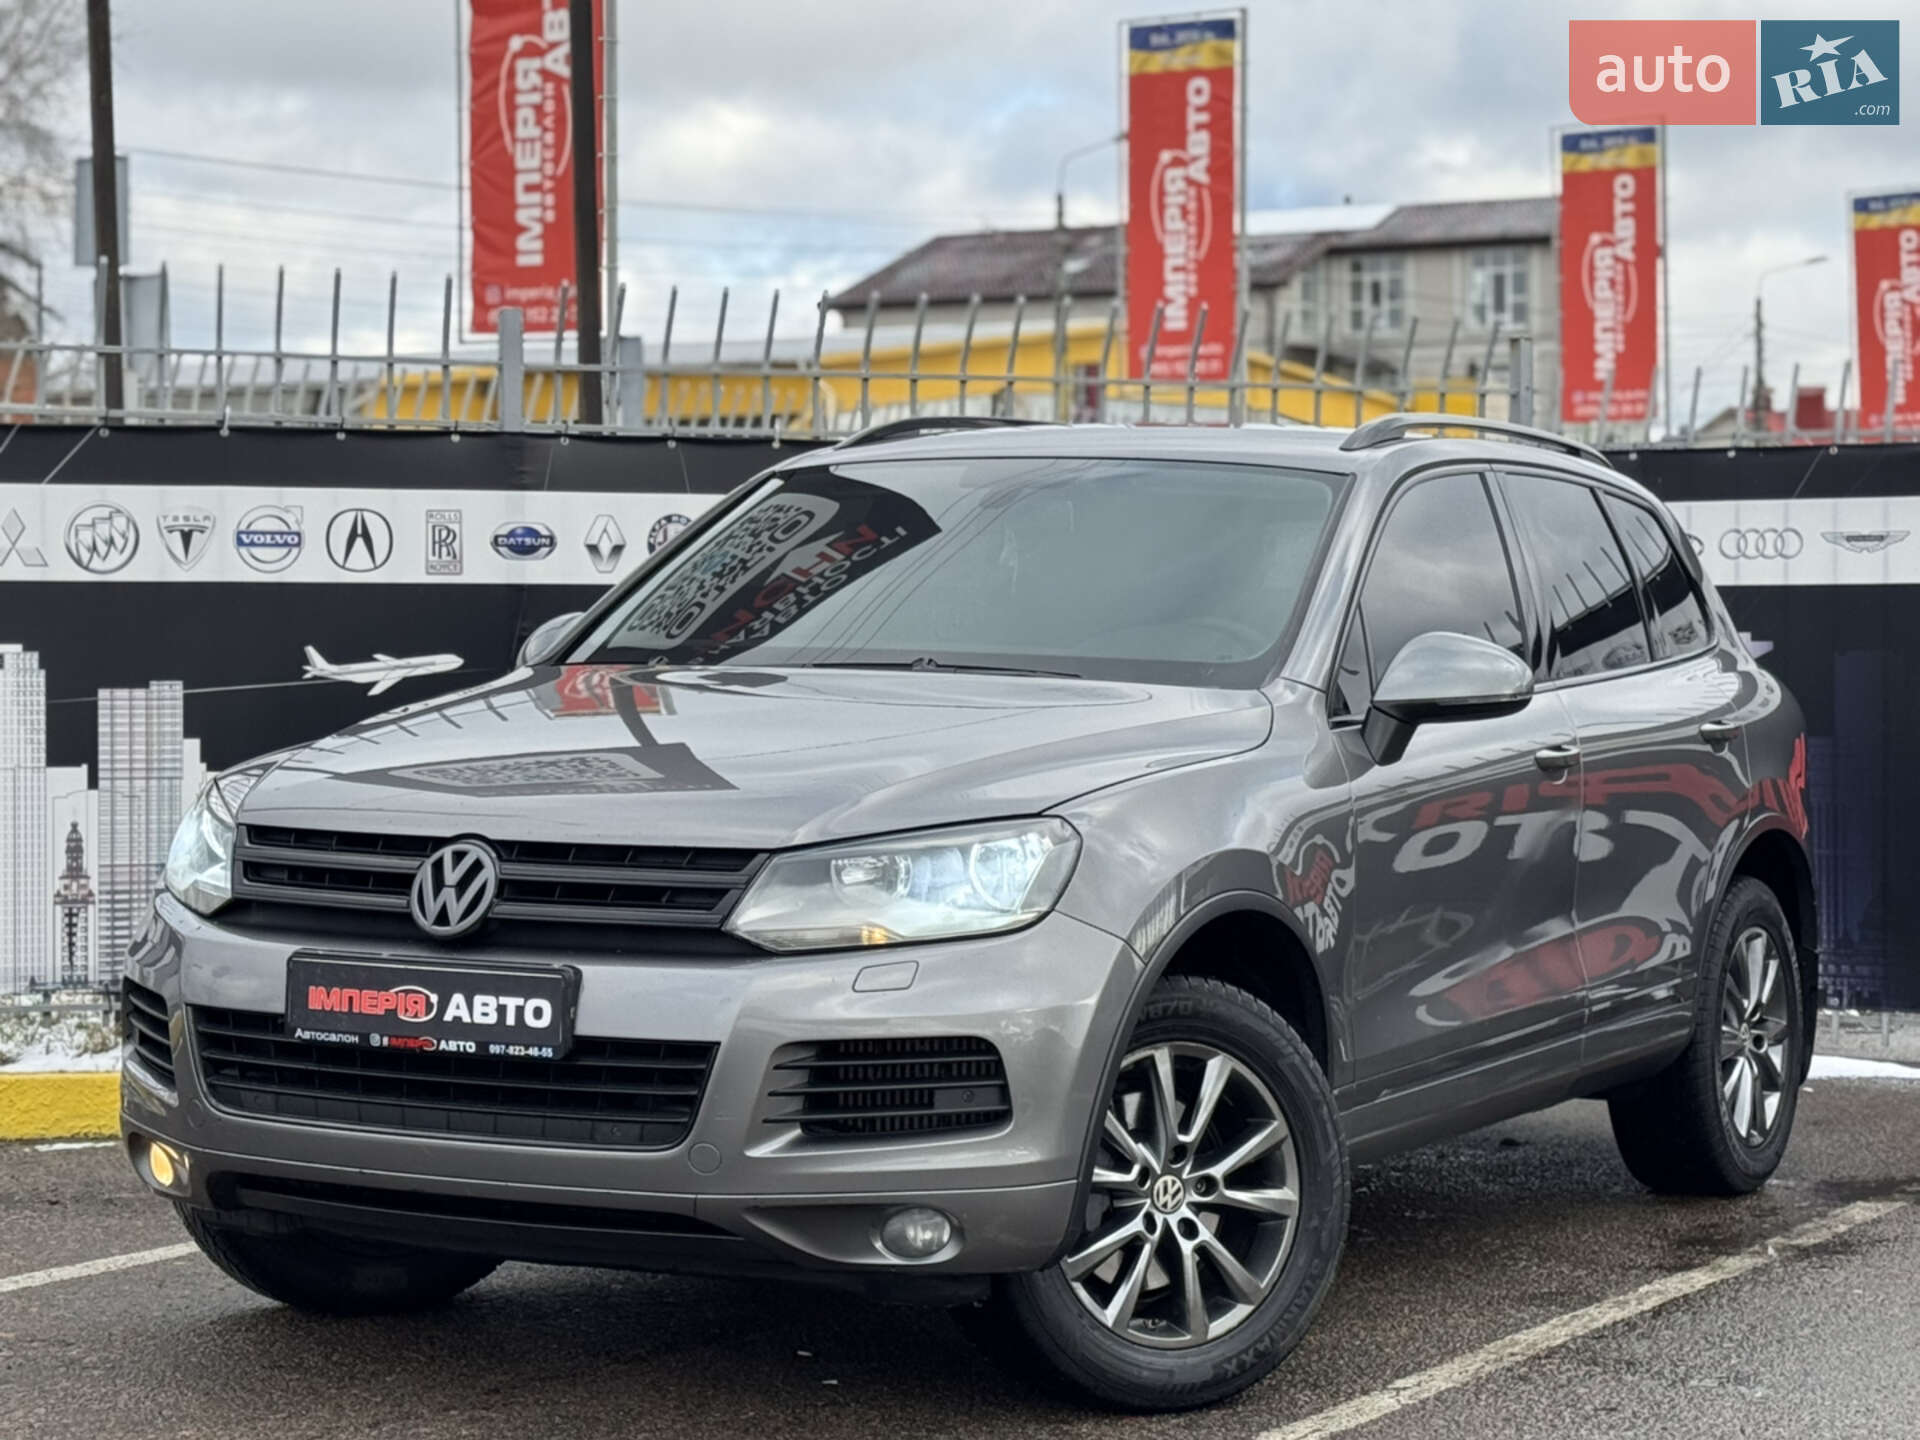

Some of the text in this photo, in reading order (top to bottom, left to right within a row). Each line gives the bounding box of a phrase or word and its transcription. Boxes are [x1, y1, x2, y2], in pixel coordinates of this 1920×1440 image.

[1186, 76, 1211, 184] АВТО
[515, 56, 544, 267] ІМПЕРІЯ
[1613, 173, 1637, 261] АВТО
[1163, 165, 1188, 331] ІМПЕРІЯ
[161, 515, 212, 523] TESLA
[429, 513, 459, 521] ROLLS
[240, 534, 299, 544] VOLVO
[496, 536, 552, 547] DATSUN
[307, 985, 553, 1028] ІМПЕРІЯ АВТО
[294, 1027, 360, 1044] Автосалон
[438, 1039, 476, 1053] АВТО
